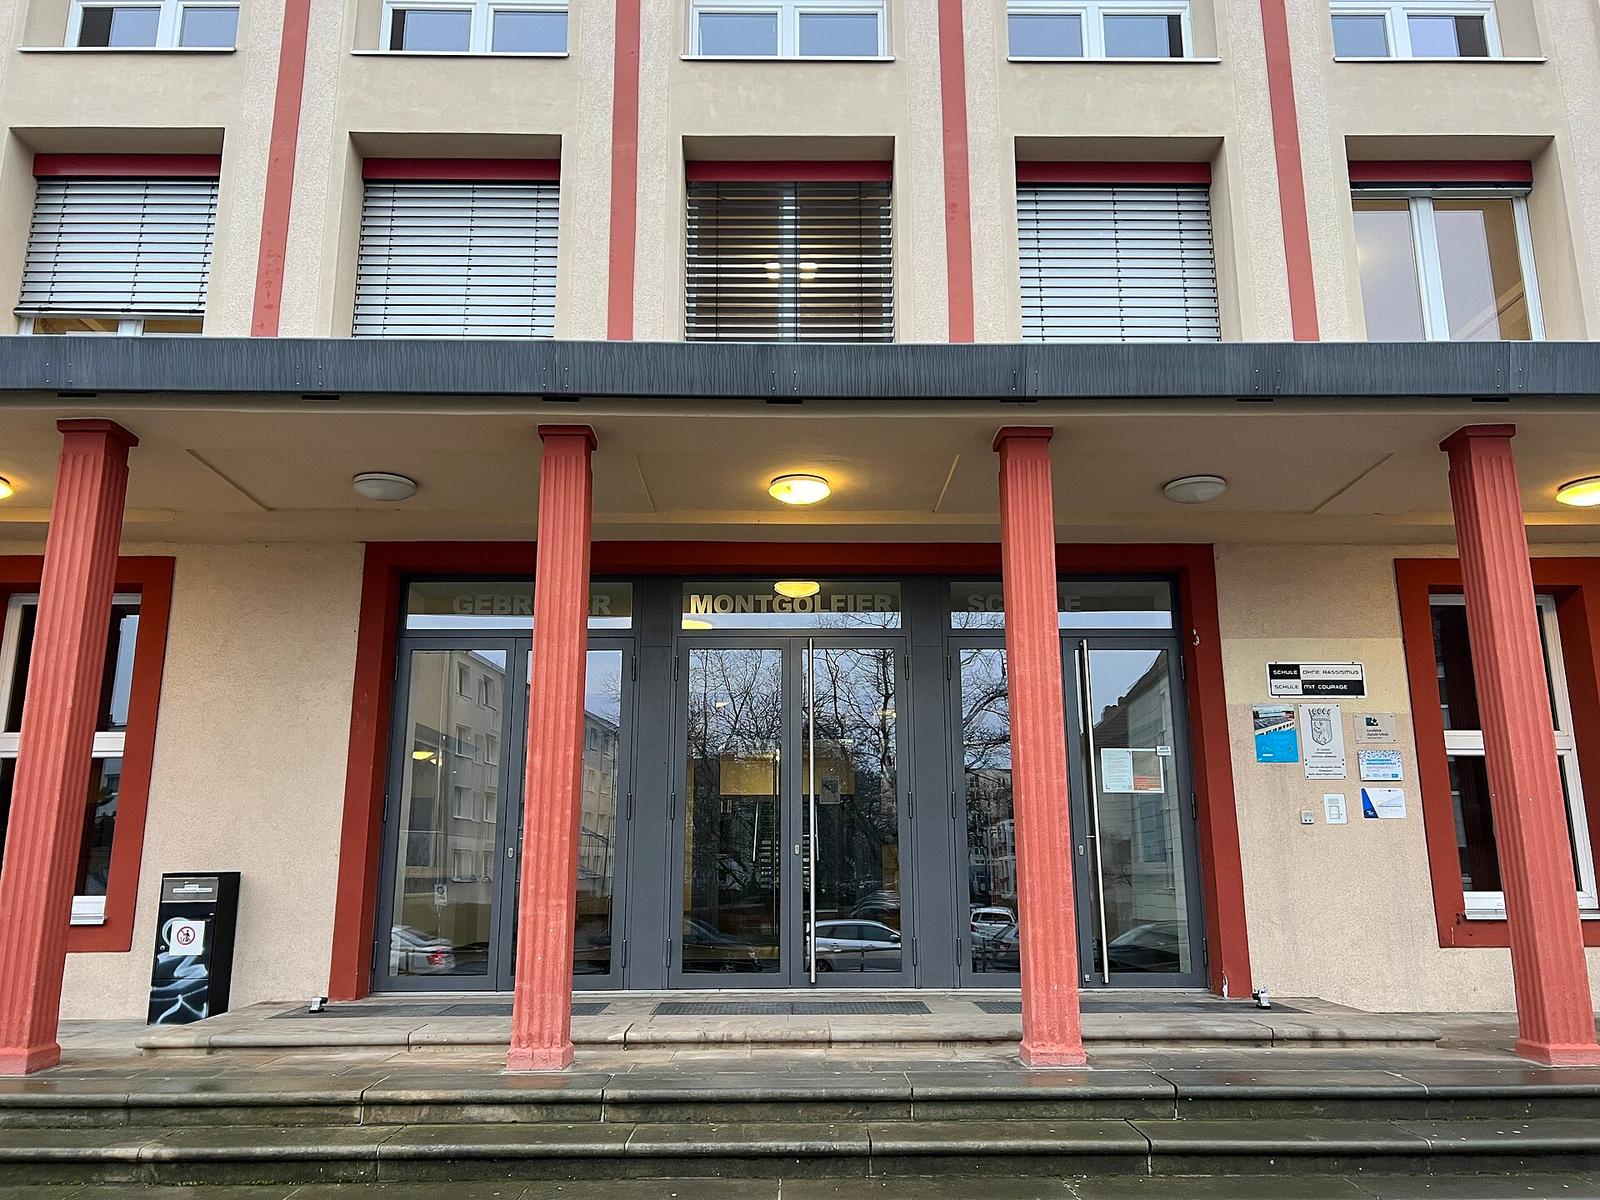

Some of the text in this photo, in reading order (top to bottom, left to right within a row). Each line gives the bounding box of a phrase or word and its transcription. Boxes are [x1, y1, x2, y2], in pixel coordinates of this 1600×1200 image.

[452, 593, 1081, 615] GEBRR MONTGOLFIER SCE
